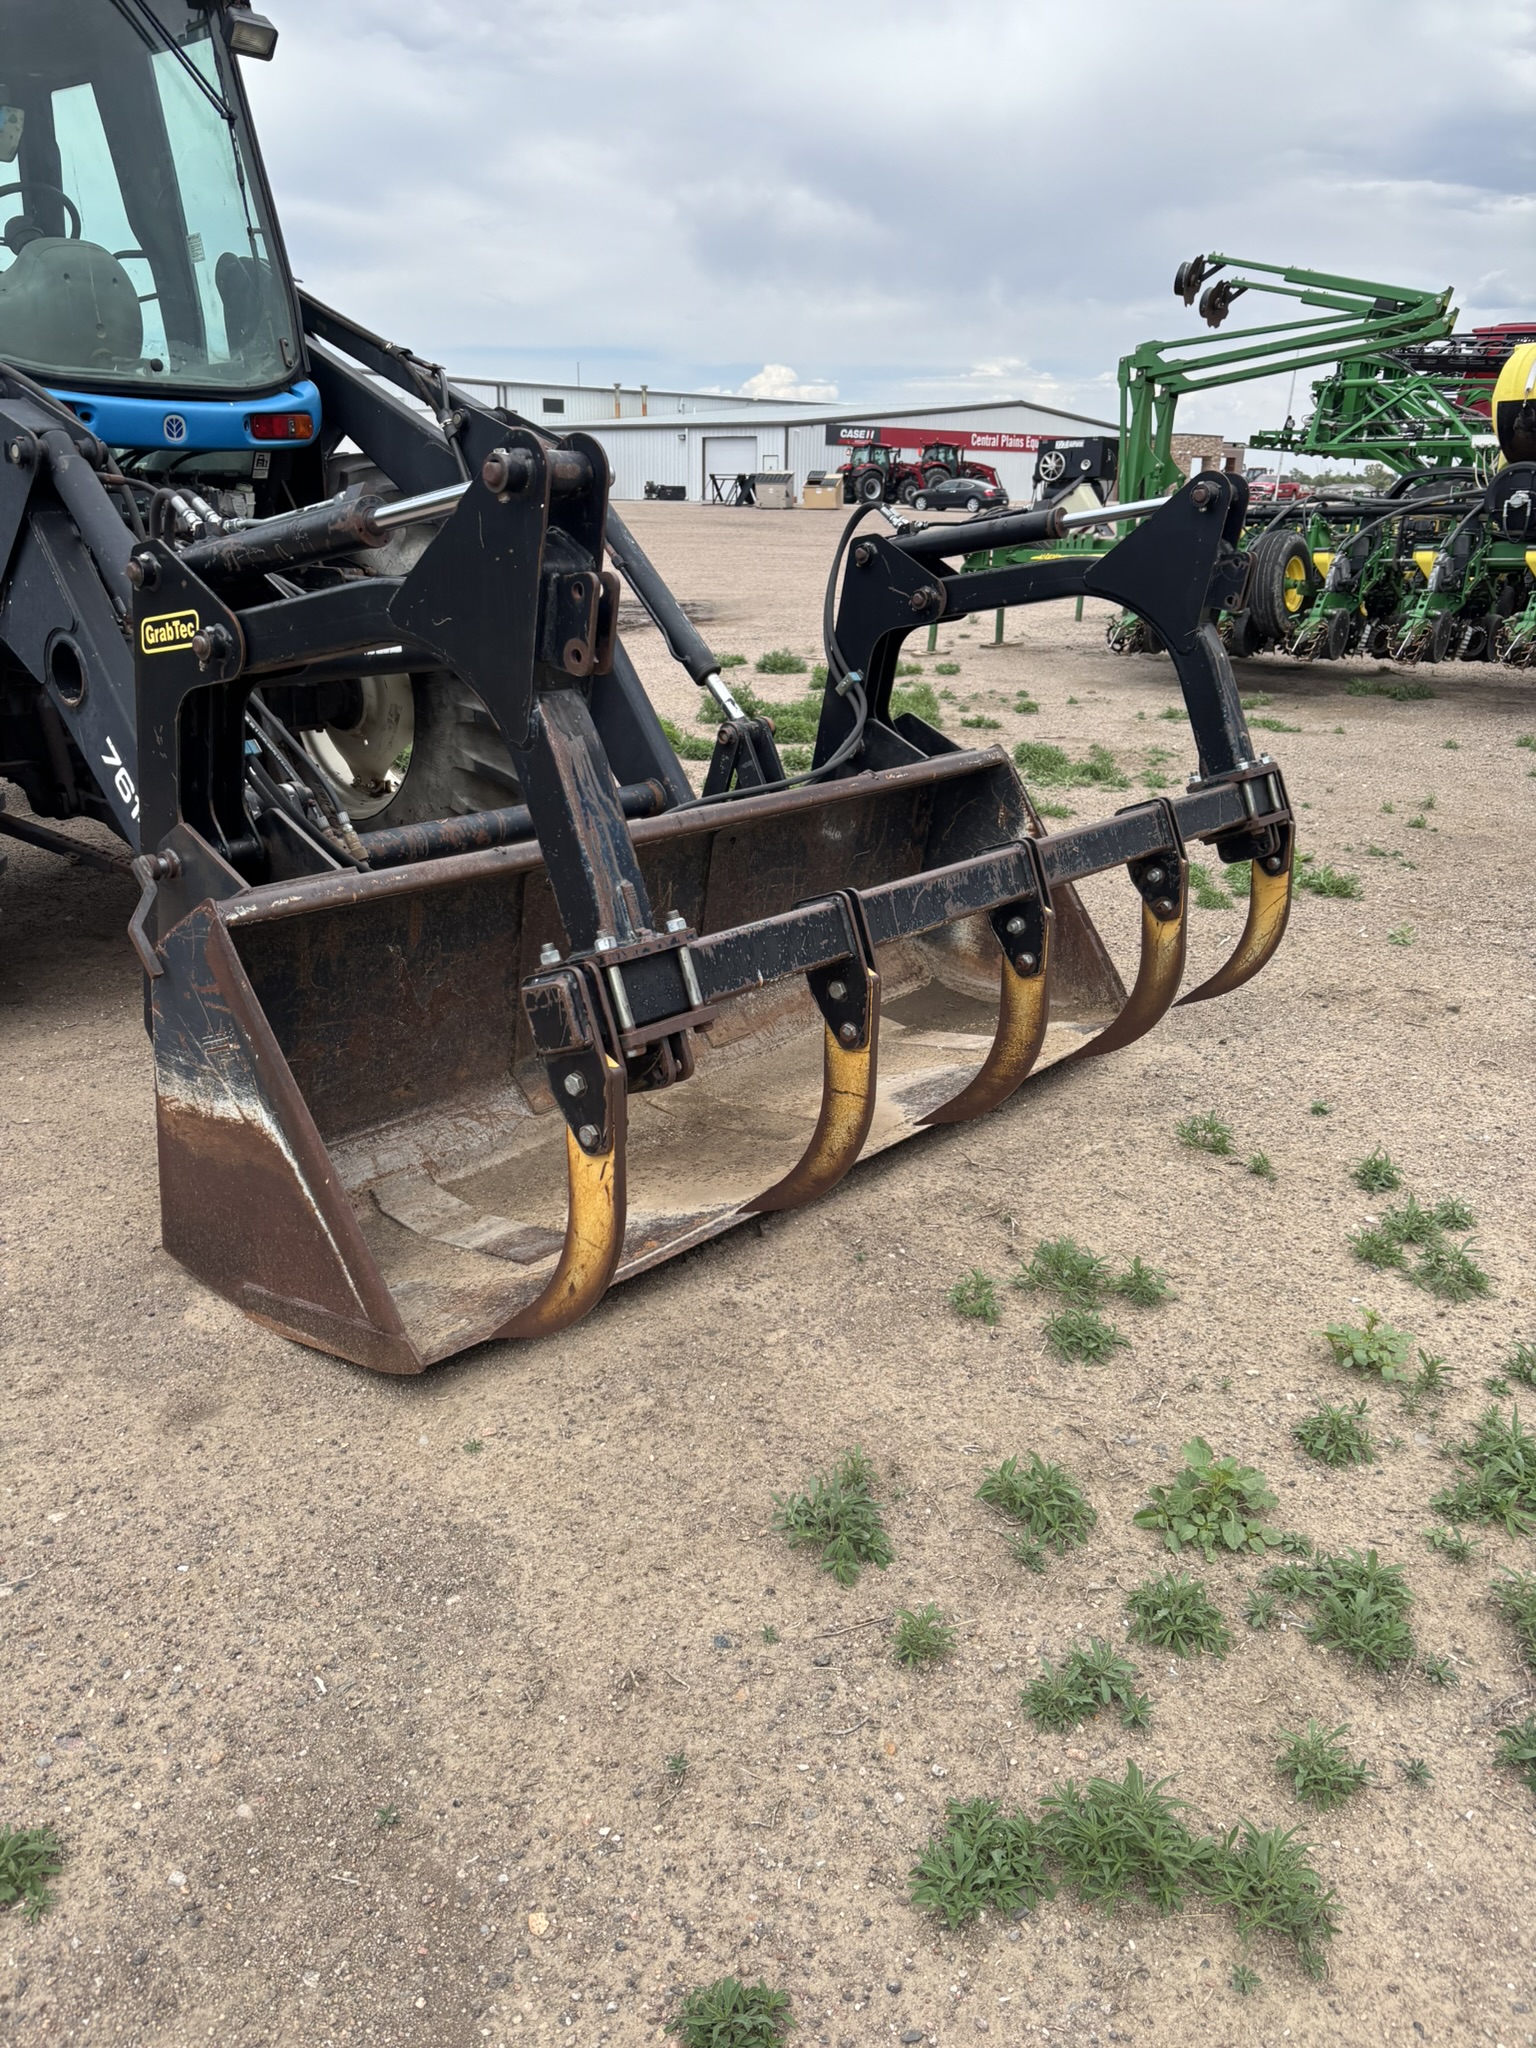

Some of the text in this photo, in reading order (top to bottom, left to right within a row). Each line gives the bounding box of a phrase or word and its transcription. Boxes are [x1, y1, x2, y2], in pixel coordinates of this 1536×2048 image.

[840, 428, 866, 439] CASE
[971, 433, 999, 448] Central
[1001, 434, 1024, 448] Plains
[1025, 435, 1042, 451] Equ
[145, 619, 196, 645] GrabTec
[101, 735, 141, 824] 761
